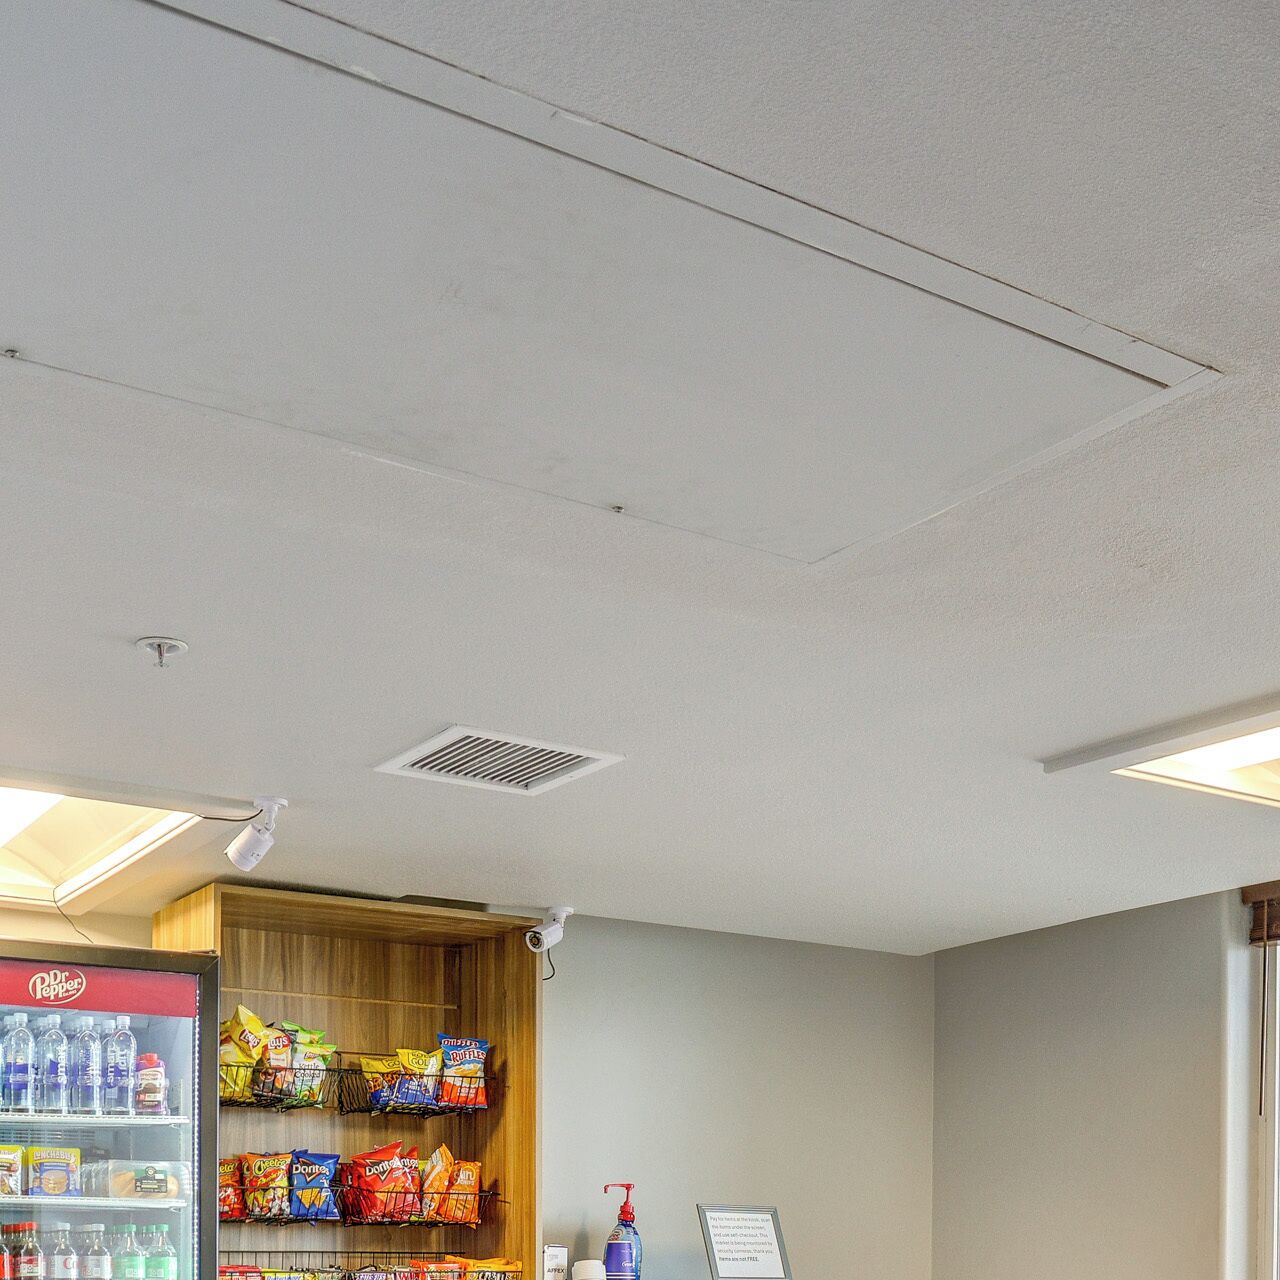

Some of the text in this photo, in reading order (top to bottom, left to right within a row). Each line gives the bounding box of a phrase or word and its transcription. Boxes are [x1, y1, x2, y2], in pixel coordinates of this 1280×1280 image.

[49, 969, 69, 985] Dr
[33, 972, 82, 1000] Pepper
[268, 1037, 288, 1049] Lay's
[451, 1048, 486, 1063] RUFFLES
[292, 1164, 329, 1175] Doritos
